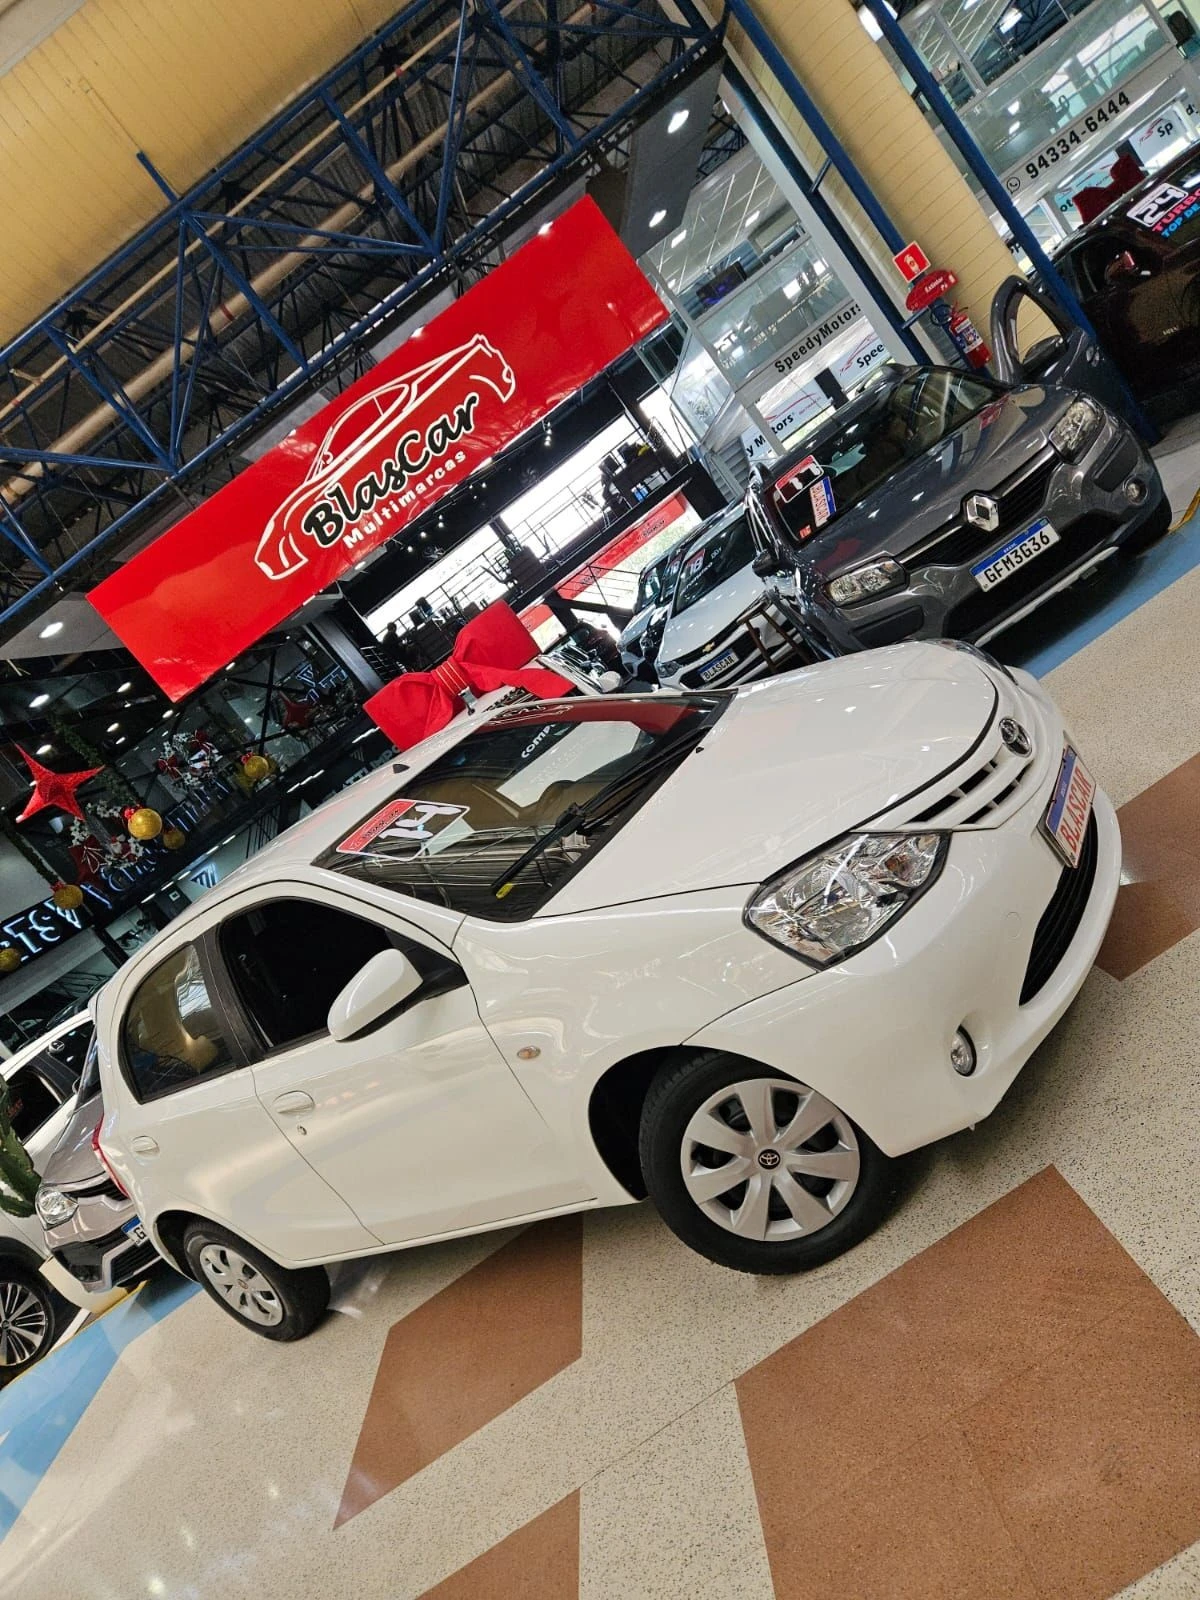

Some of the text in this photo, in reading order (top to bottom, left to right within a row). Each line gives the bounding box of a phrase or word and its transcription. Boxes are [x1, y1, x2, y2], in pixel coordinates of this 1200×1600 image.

[1026, 91, 1130, 179] 94334-6444
[1134, 188, 1184, 227] 24
[1161, 218, 1184, 238] TOP
[857, 344, 885, 368] Spee
[303, 394, 479, 547] BlasCar
[342, 450, 466, 549] Multimarcas
[984, 531, 1050, 583] GFM3G36
[703, 655, 735, 679] BLASCAR
[1060, 766, 1091, 853] BLASCAR
